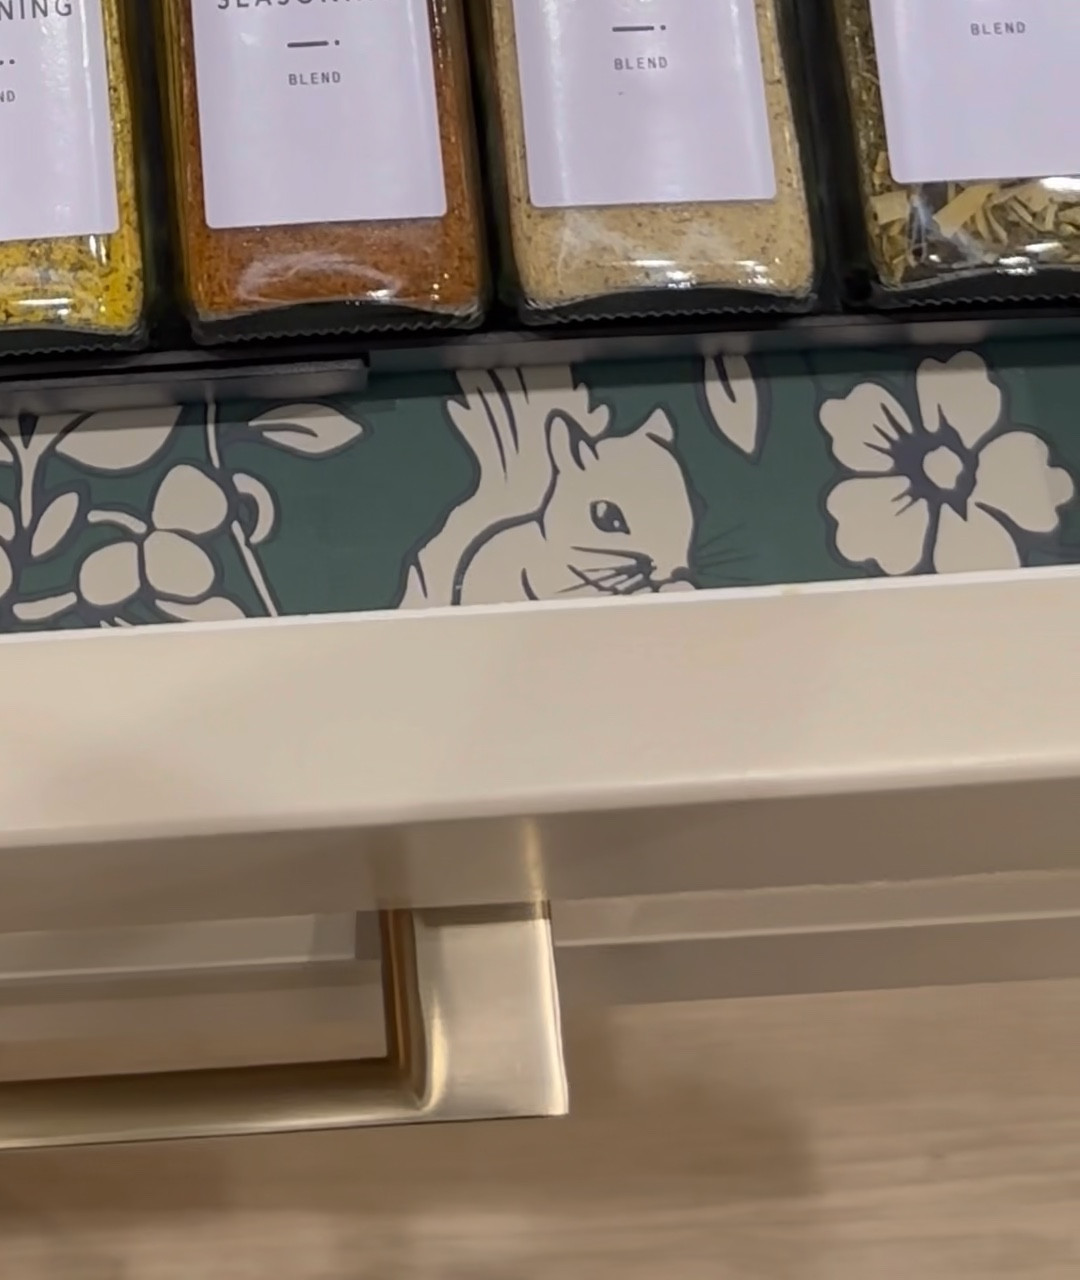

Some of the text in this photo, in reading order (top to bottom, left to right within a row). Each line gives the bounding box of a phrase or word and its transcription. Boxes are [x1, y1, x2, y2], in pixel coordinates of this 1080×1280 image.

[969, 20, 1026, 37] BLEND
[613, 55, 669, 71] BLEND
[287, 70, 341, 86] BLEND
